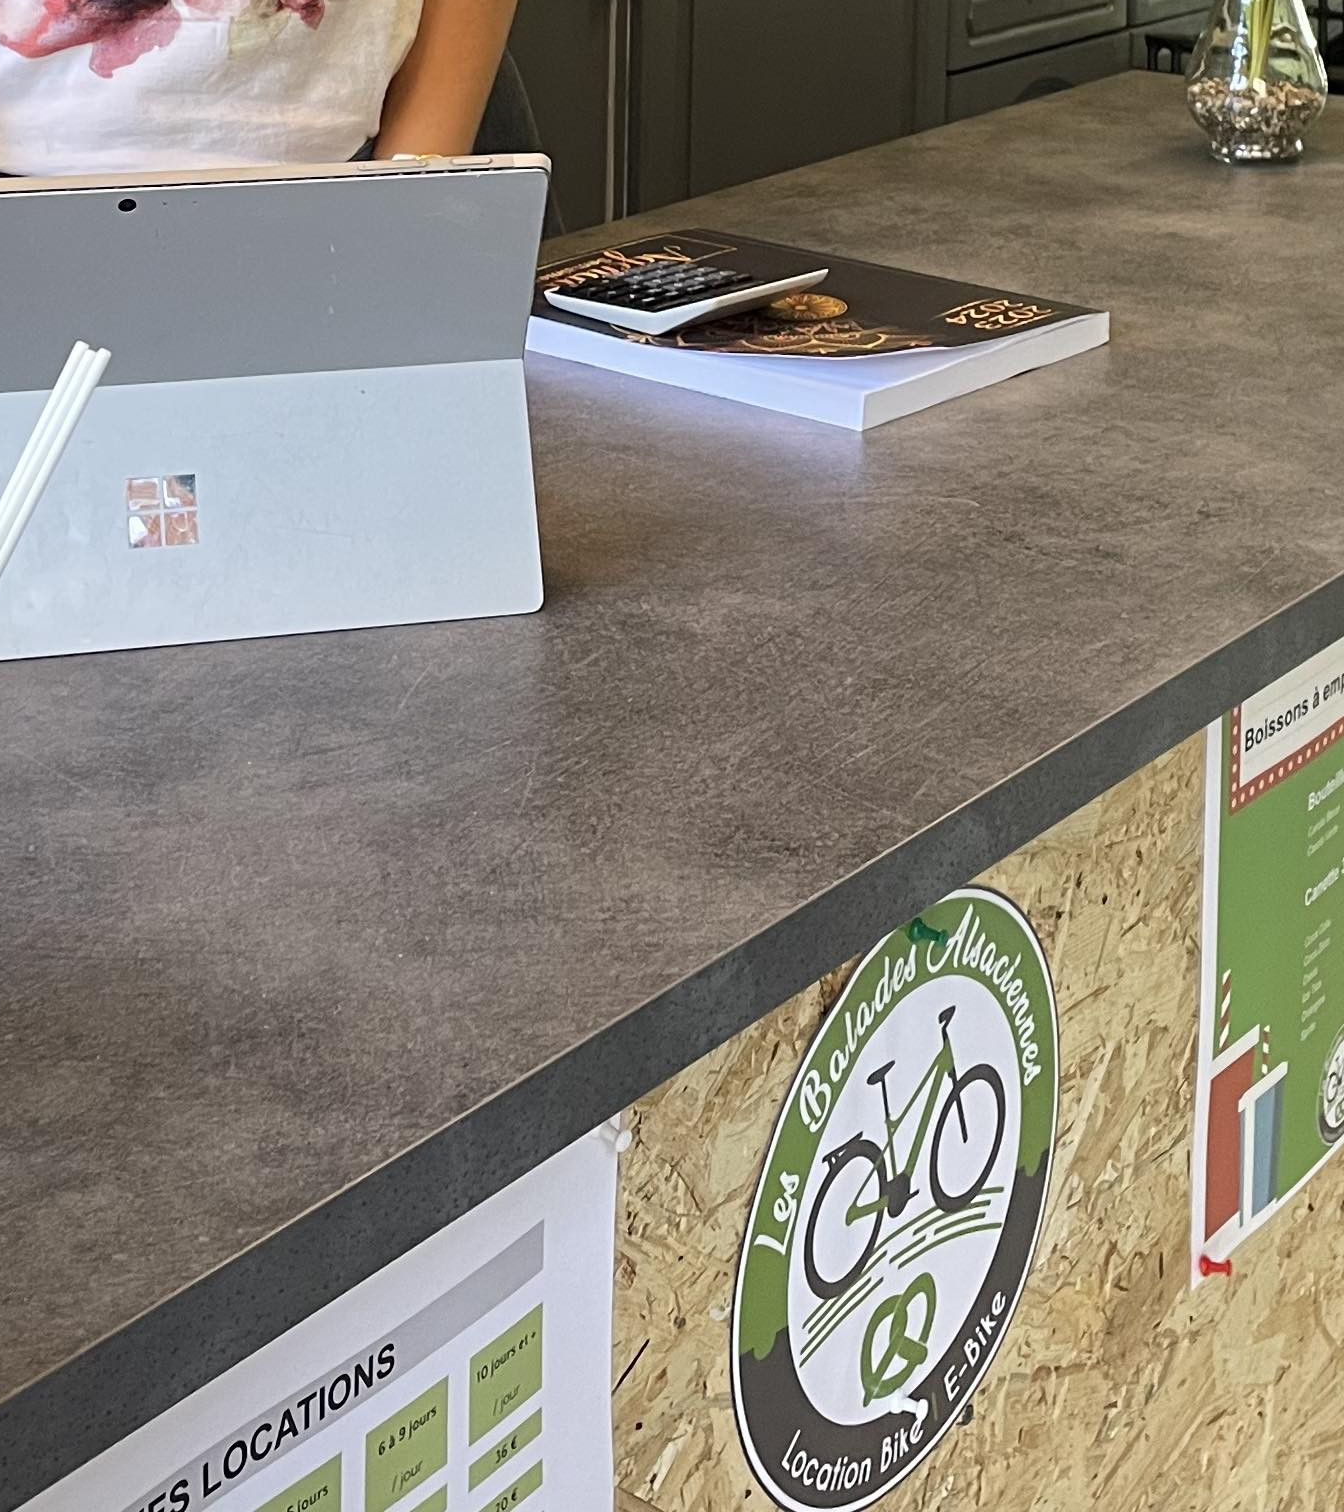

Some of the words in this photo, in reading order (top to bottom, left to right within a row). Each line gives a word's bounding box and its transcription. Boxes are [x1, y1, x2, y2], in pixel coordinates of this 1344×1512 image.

[946, 300, 1023, 325] 2024
[975, 305, 1052, 329] 2023
[1245, 698, 1308, 752] Boissons
[1312, 686, 1320, 709] à
[1305, 867, 1340, 906] Canette
[754, 1171, 799, 1255] Les
[799, 944, 917, 1133] Balades
[926, 903, 1042, 1086] Alsaciennes
[476, 1365, 489, 1383] 10
[490, 1347, 516, 1378] jours
[518, 1334, 529, 1350] et
[499, 1384, 521, 1414] jour
[781, 1429, 872, 1492] Location
[880, 1420, 924, 1474] Bike
[943, 1291, 1007, 1402] E-Bike
[202, 1343, 396, 1498] LOCATIONS
[378, 1441, 386, 1456] 6
[388, 1434, 396, 1450] à
[398, 1426, 406, 1442] 9
[408, 1406, 437, 1439] jours
[399, 1460, 423, 1491] jour
[297, 1486, 329, 1512] jours
